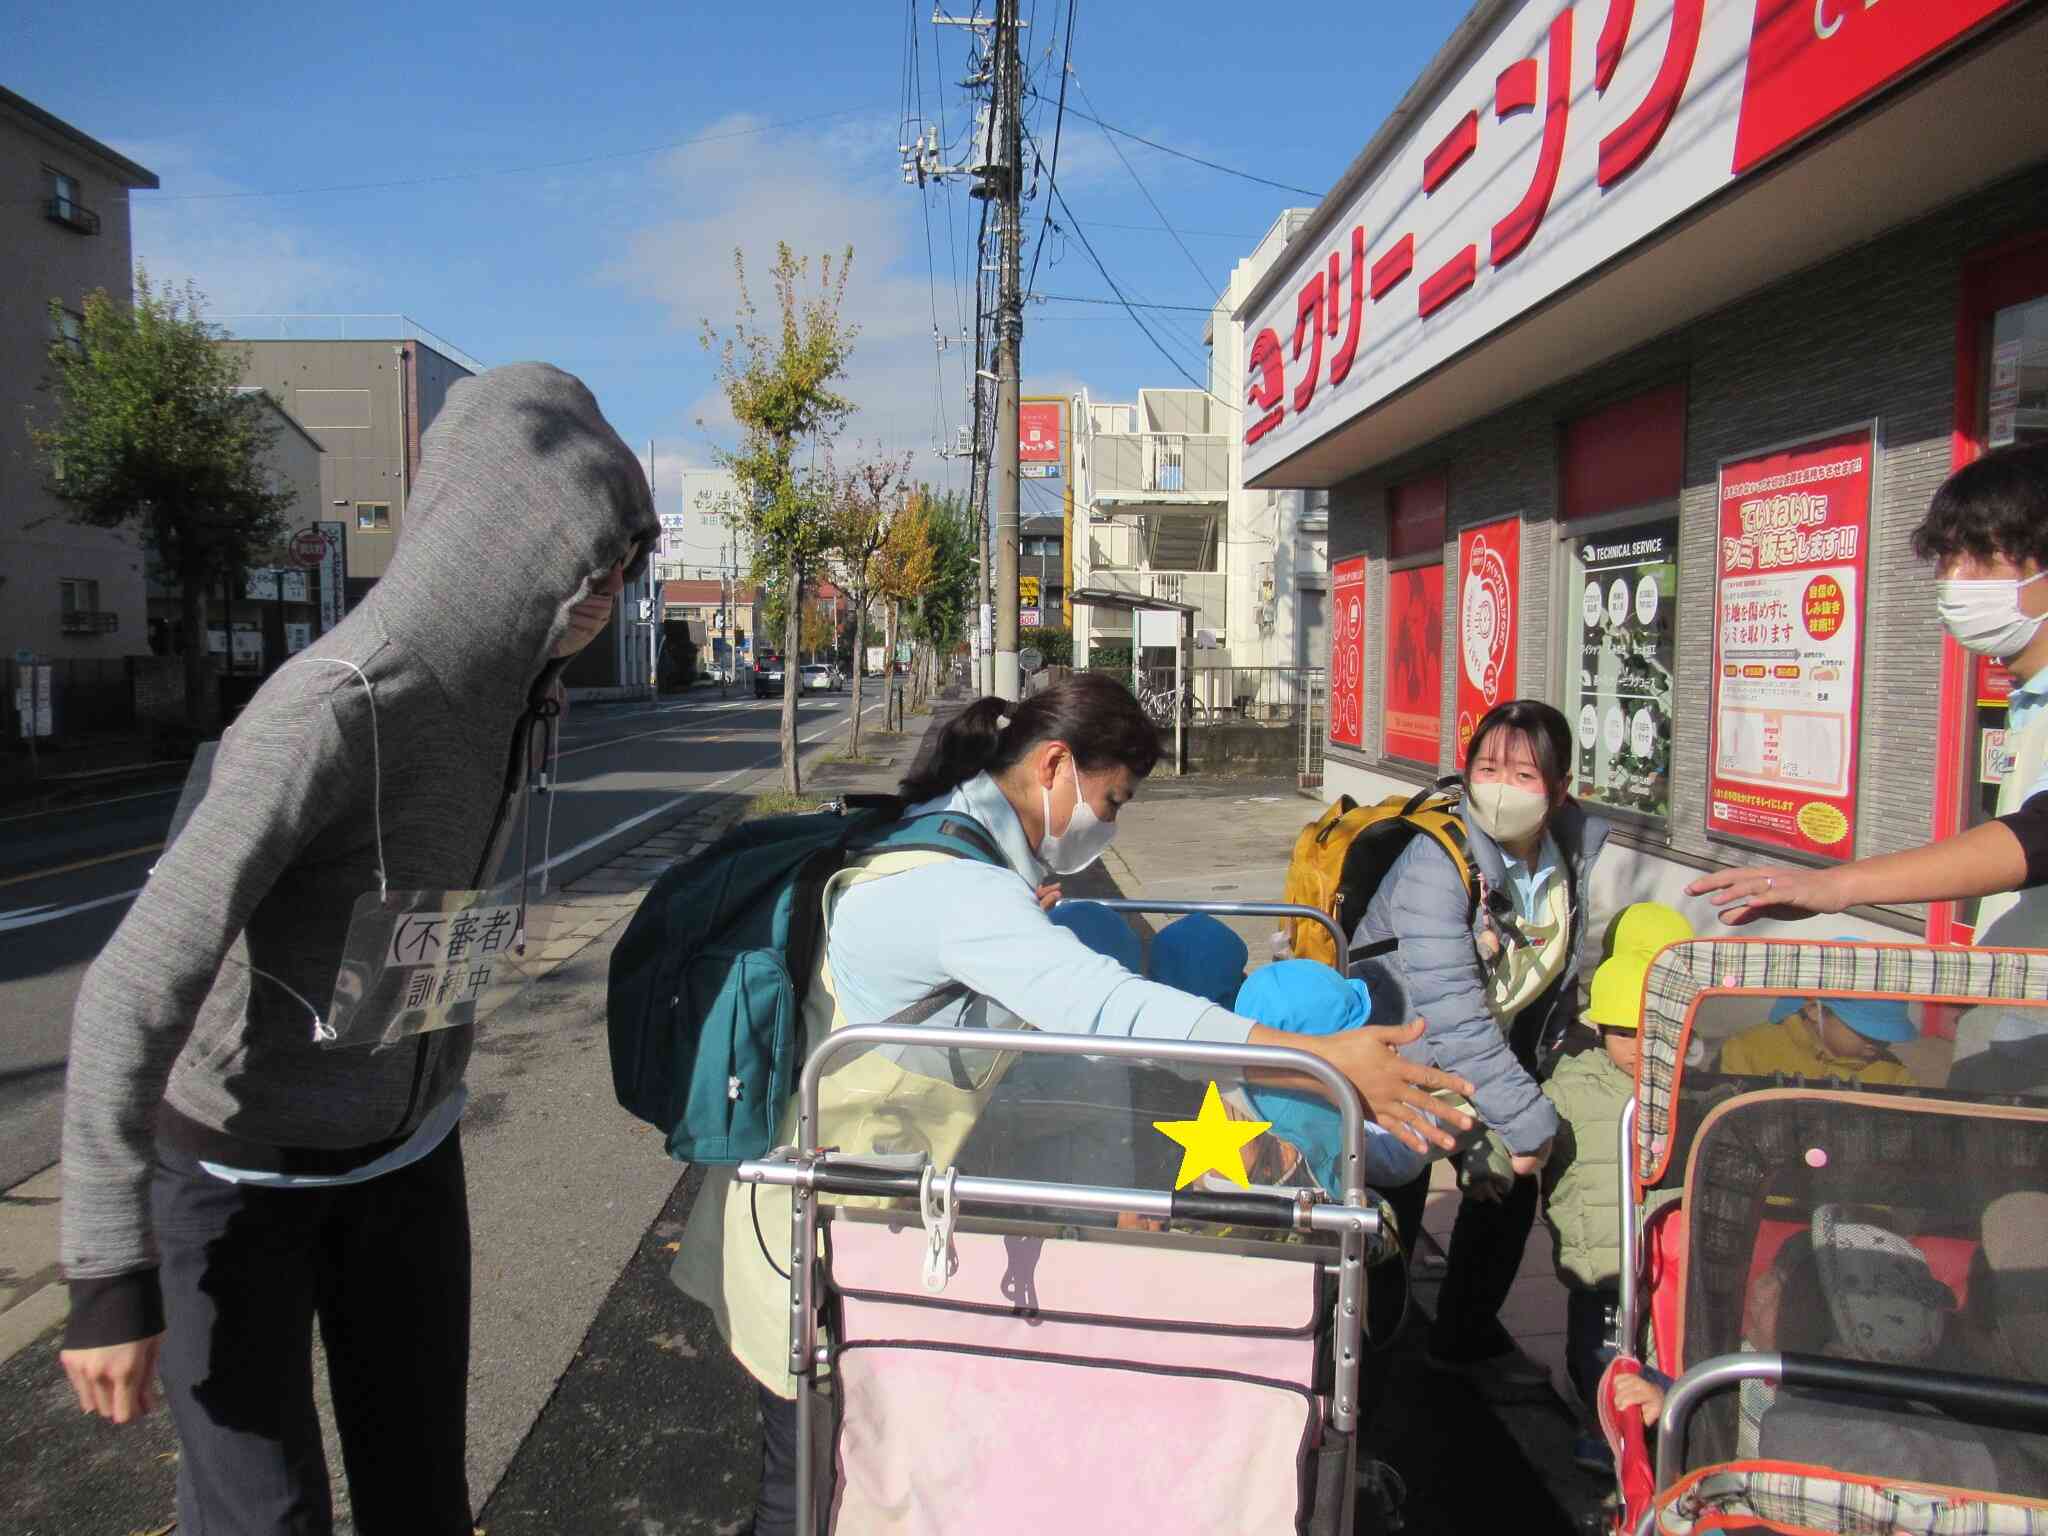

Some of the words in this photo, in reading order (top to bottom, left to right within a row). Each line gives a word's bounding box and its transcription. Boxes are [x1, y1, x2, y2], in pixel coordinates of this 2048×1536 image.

[1741, 493, 1828, 533] ていねいに
[1596, 542, 1631, 561] TECHNICAL
[1632, 537, 1662, 556] SERVICE
[1806, 601, 1841, 616] しみ抜き
[1724, 623, 1794, 646] シミを取ります
[393, 907, 522, 963] (不審者)
[406, 963, 491, 1008] 訓練中
